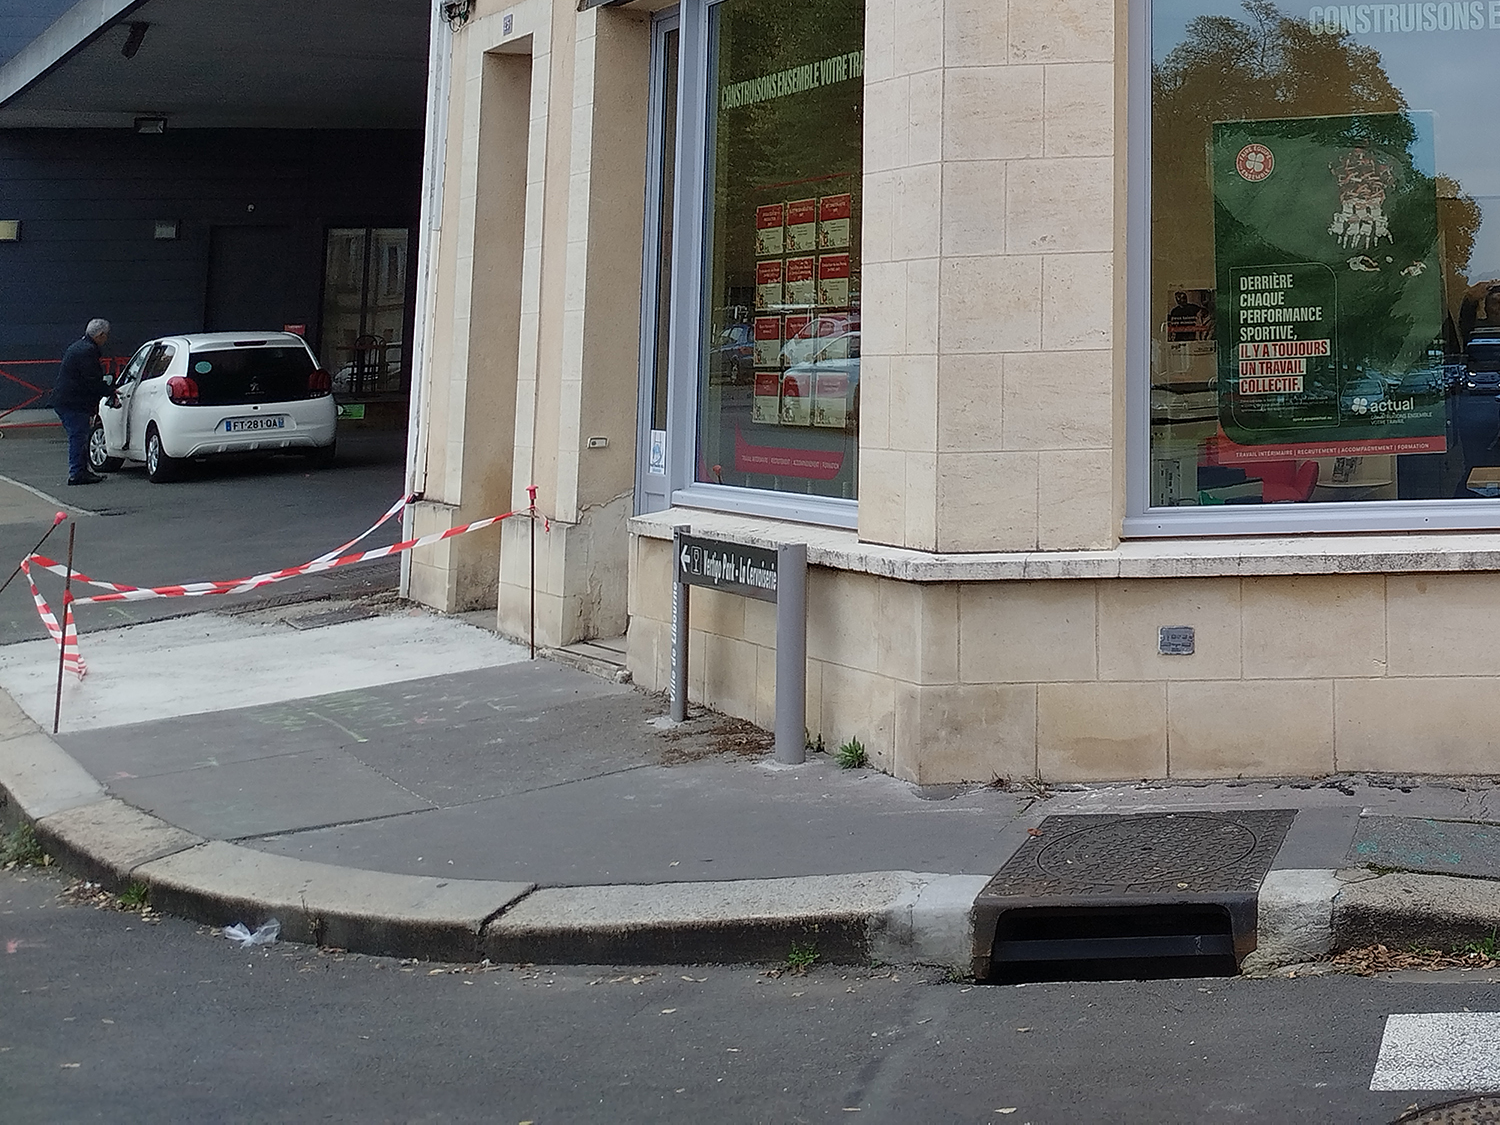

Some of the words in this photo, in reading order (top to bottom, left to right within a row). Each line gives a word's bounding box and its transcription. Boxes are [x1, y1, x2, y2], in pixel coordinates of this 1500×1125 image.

[1309, 1, 1485, 36] CONSTRUISONS
[721, 73, 777, 110] CONSTRUISONS
[777, 62, 820, 97] ENSEMBLE
[819, 54, 848, 86] VOTRE
[1240, 272, 1293, 291] DERRIÈRE
[1240, 292, 1285, 307] CHAQUE
[1240, 307, 1322, 324] PERFORMANCE
[1240, 325, 1297, 341] SPORTIVE,
[1241, 344, 1251, 358] IL
[1252, 344, 1260, 357] Y
[1262, 343, 1270, 357] A
[1271, 341, 1328, 356] TOUJOURS
[1241, 362, 1256, 376] UN
[1258, 360, 1304, 375] TRAVAIL
[1241, 378, 1301, 393] COLLECTIF.
[1370, 397, 1414, 412] actual
[1297, 447, 1337, 455] RECRUTEMENT
[1341, 445, 1393, 453] ACCOMPAGNEMENT
[671, 648, 677, 666] de
[669, 671, 677, 702] Ville
